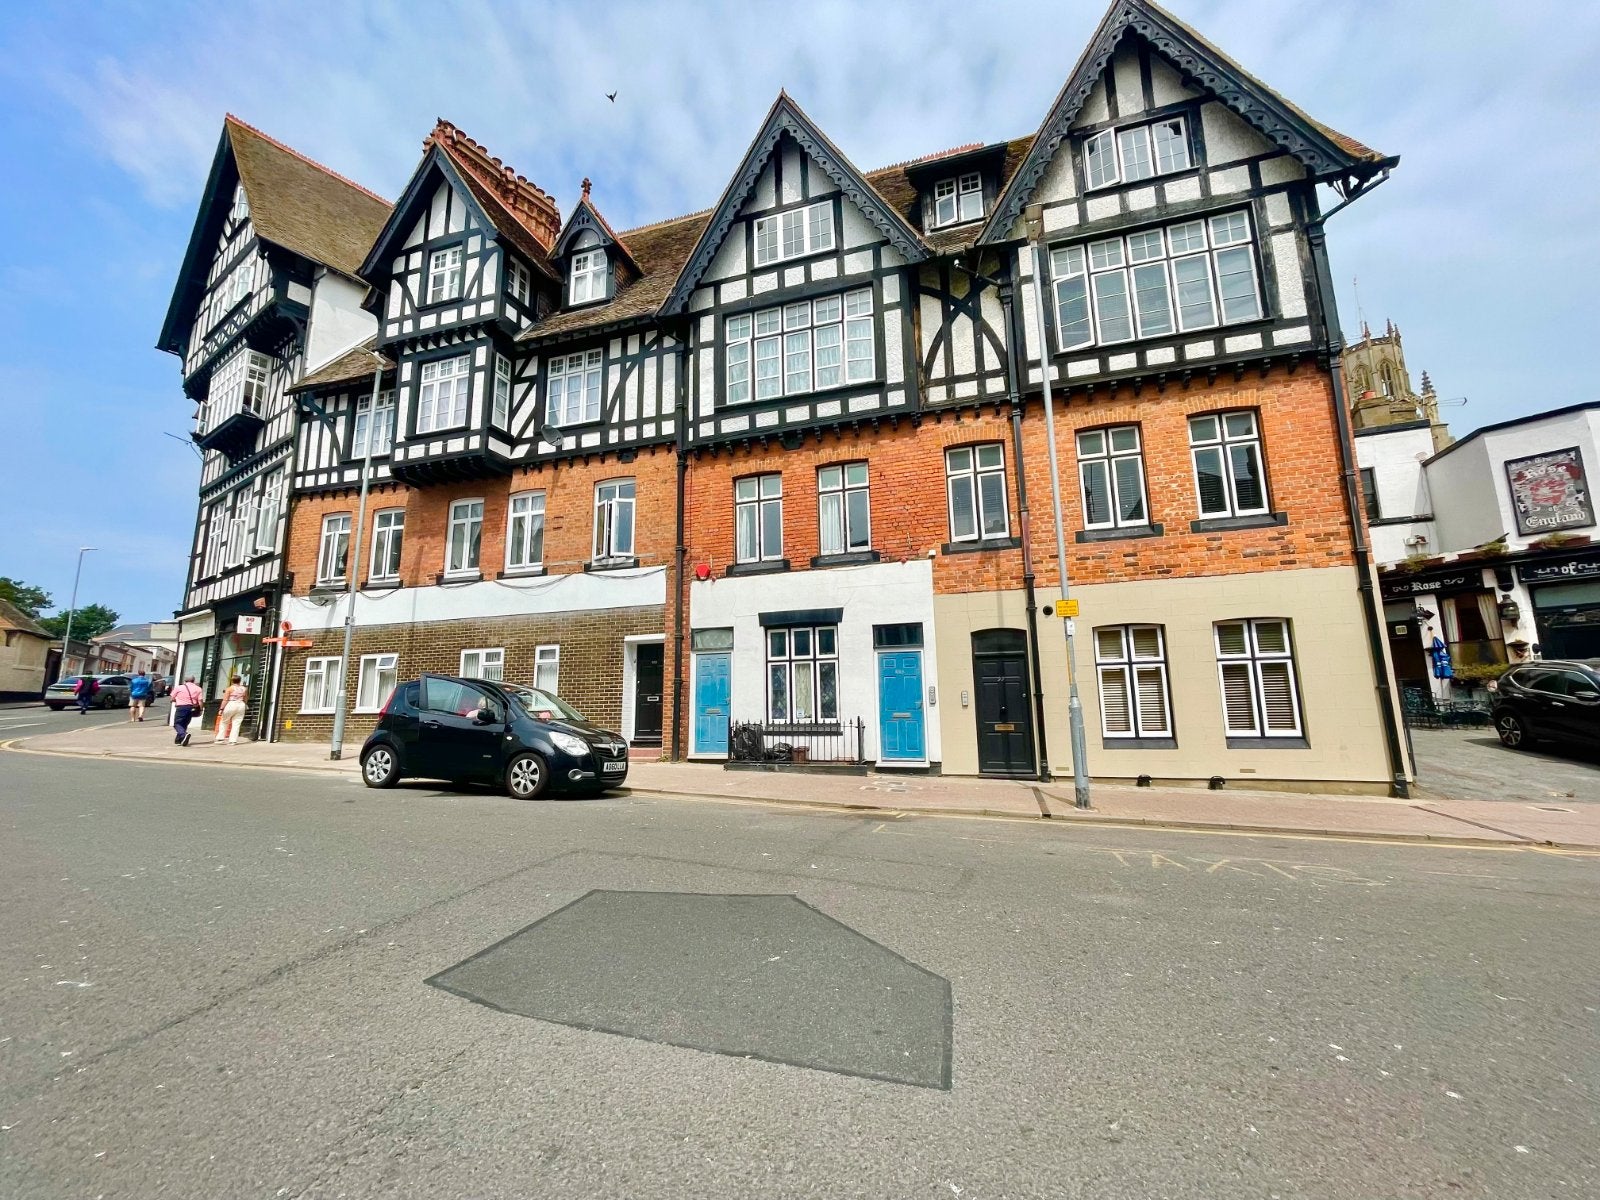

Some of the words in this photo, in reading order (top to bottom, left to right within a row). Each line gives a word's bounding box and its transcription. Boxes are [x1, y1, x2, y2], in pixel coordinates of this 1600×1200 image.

[1525, 511, 1586, 528] England
[1561, 561, 1577, 575] of
[1410, 581, 1442, 592] Rose
